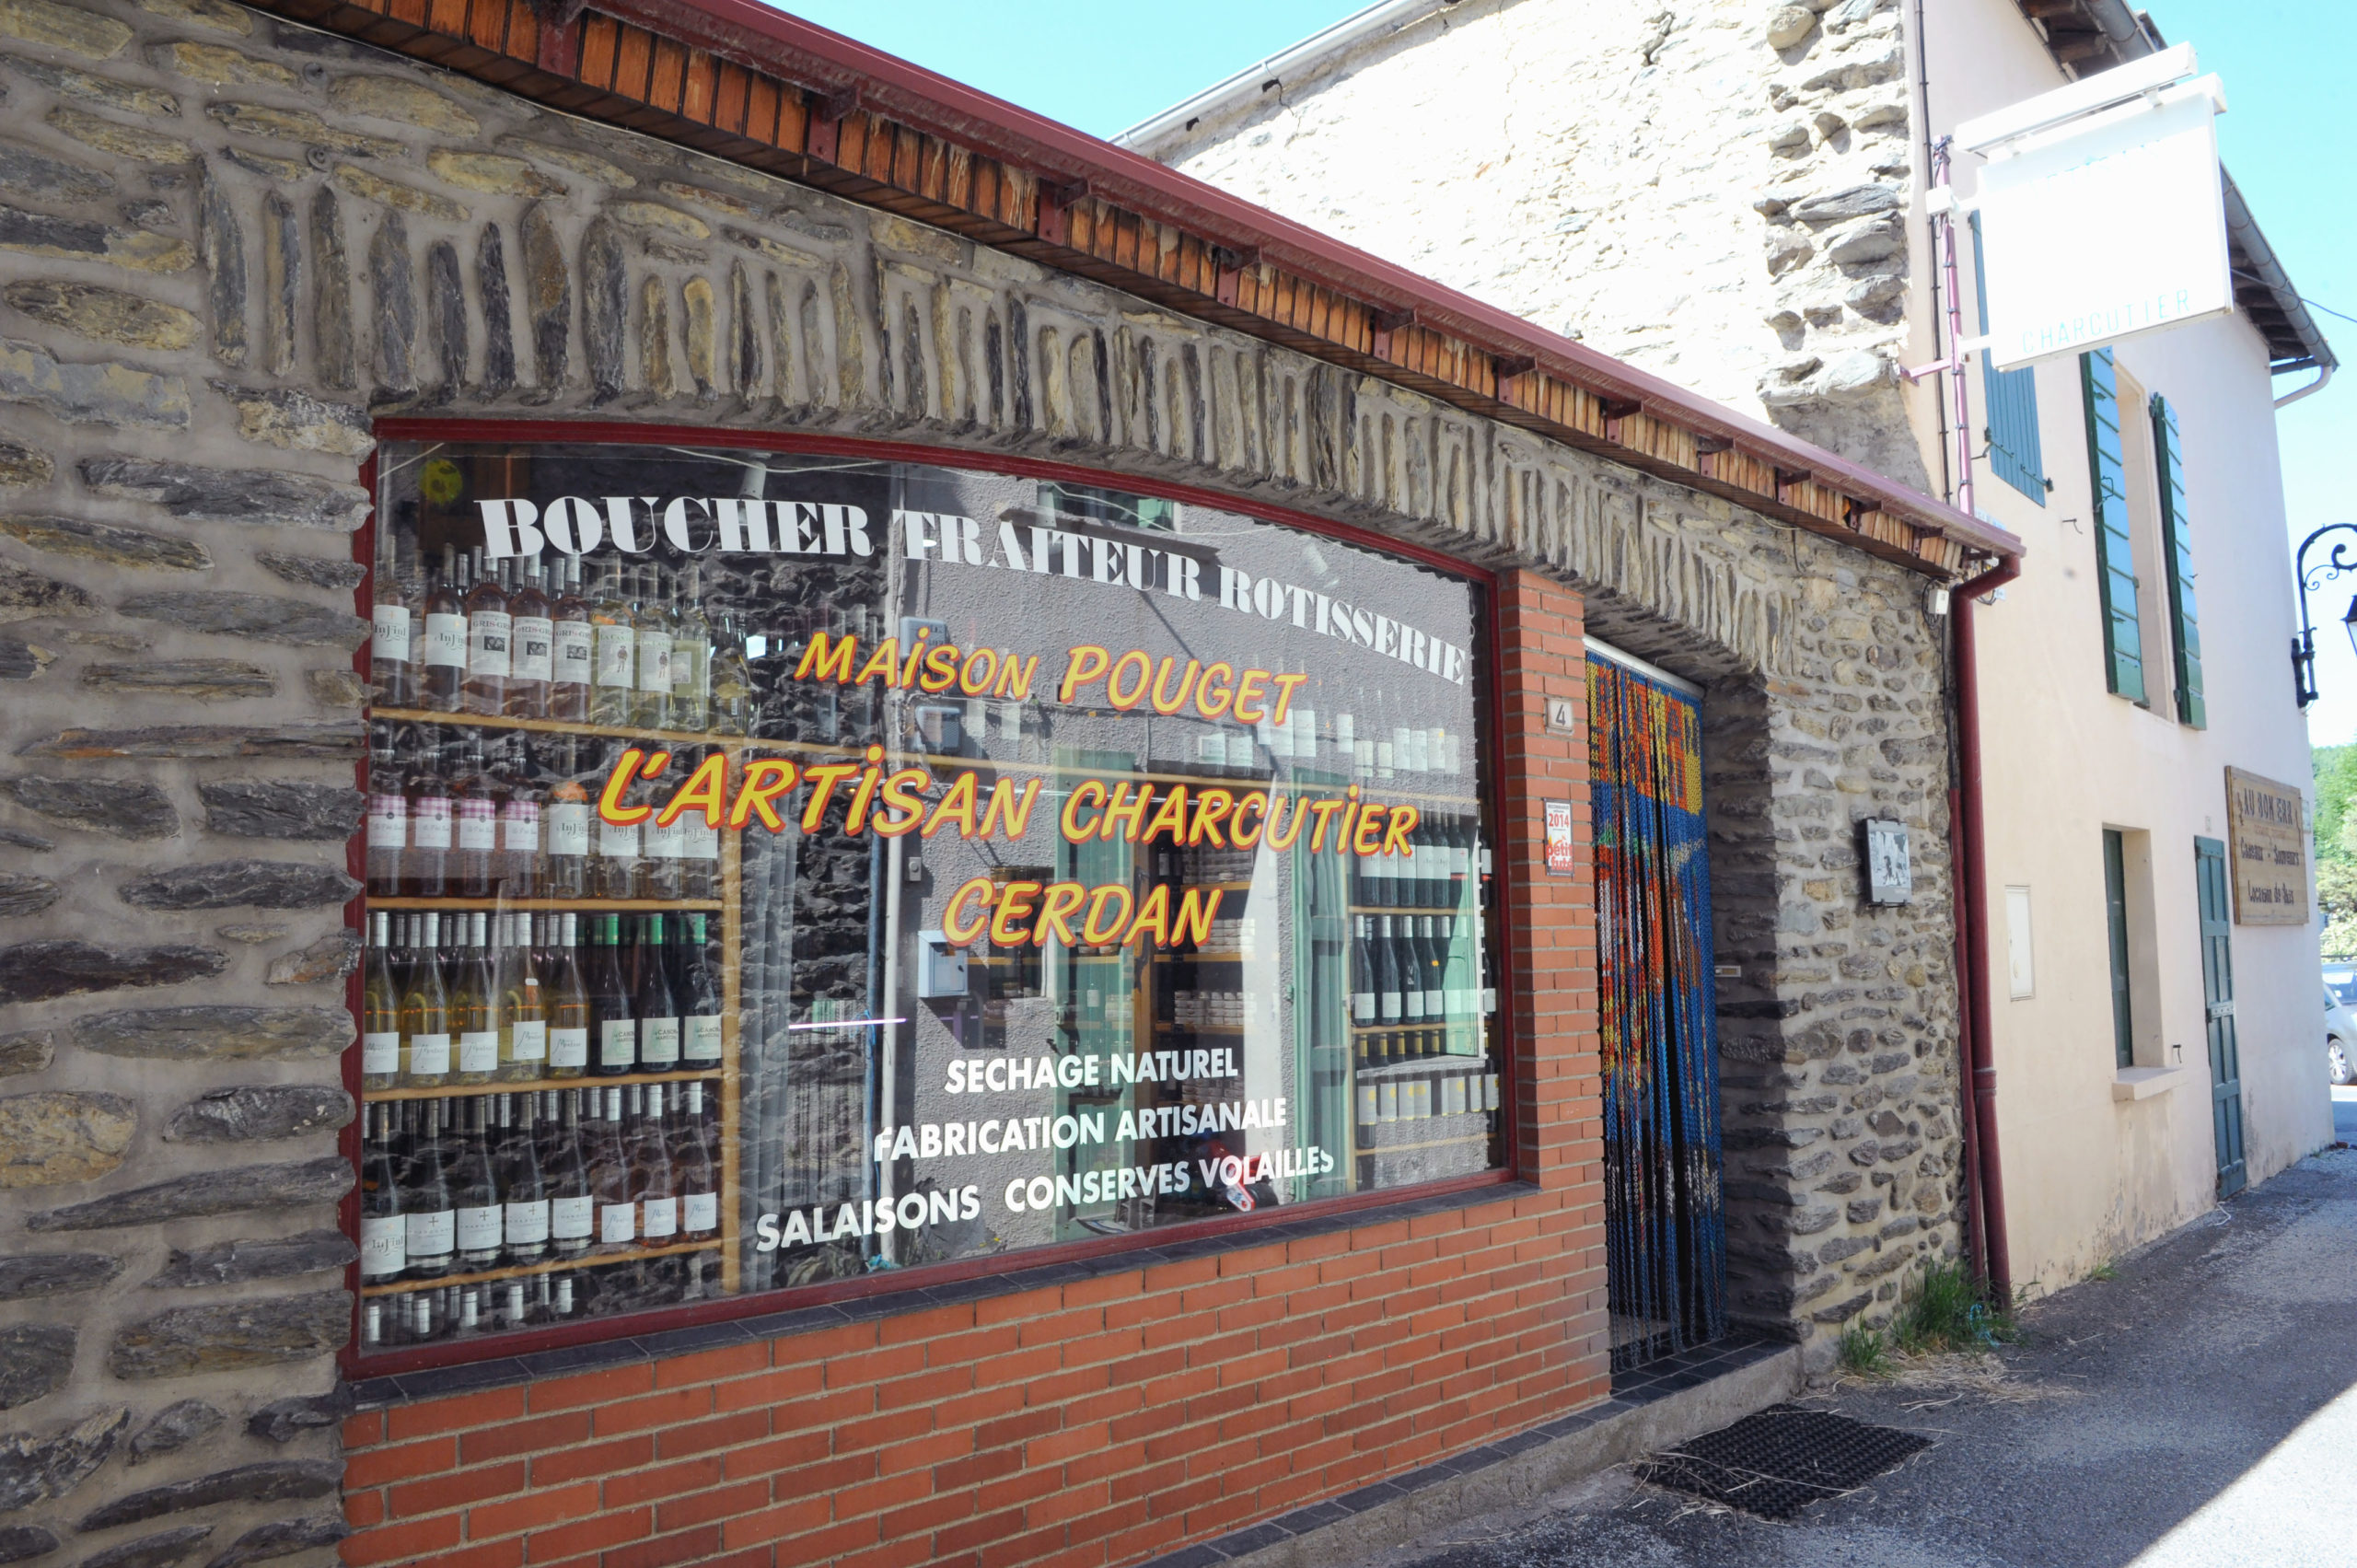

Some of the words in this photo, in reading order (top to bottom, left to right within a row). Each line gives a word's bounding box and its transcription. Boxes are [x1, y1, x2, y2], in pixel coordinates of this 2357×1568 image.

[2022, 288, 2190, 354] CHARCUTIER
[473, 495, 875, 558] BOUCHER
[892, 508, 1202, 602] TRAITEUR
[1217, 563, 1467, 686] ROTISSERIE
[1058, 644, 1309, 726] POUGET
[1555, 703, 1566, 726] 4
[1549, 813, 1570, 828] 2014
[2244, 788, 2255, 816] AU
[2258, 792, 2274, 821] BON
[942, 876, 1224, 947] CERDAN
[944, 1053, 1100, 1094] SECHAGE
[1110, 1047, 1238, 1084] NATUREL
[874, 1112, 1106, 1163] FABRICATION
[1114, 1098, 1287, 1143] ARTISANALE
[756, 1185, 981, 1251] SALAISONS
[1004, 1159, 1190, 1212] CONSERVES
[1199, 1145, 1334, 1189] VOLAILLES
